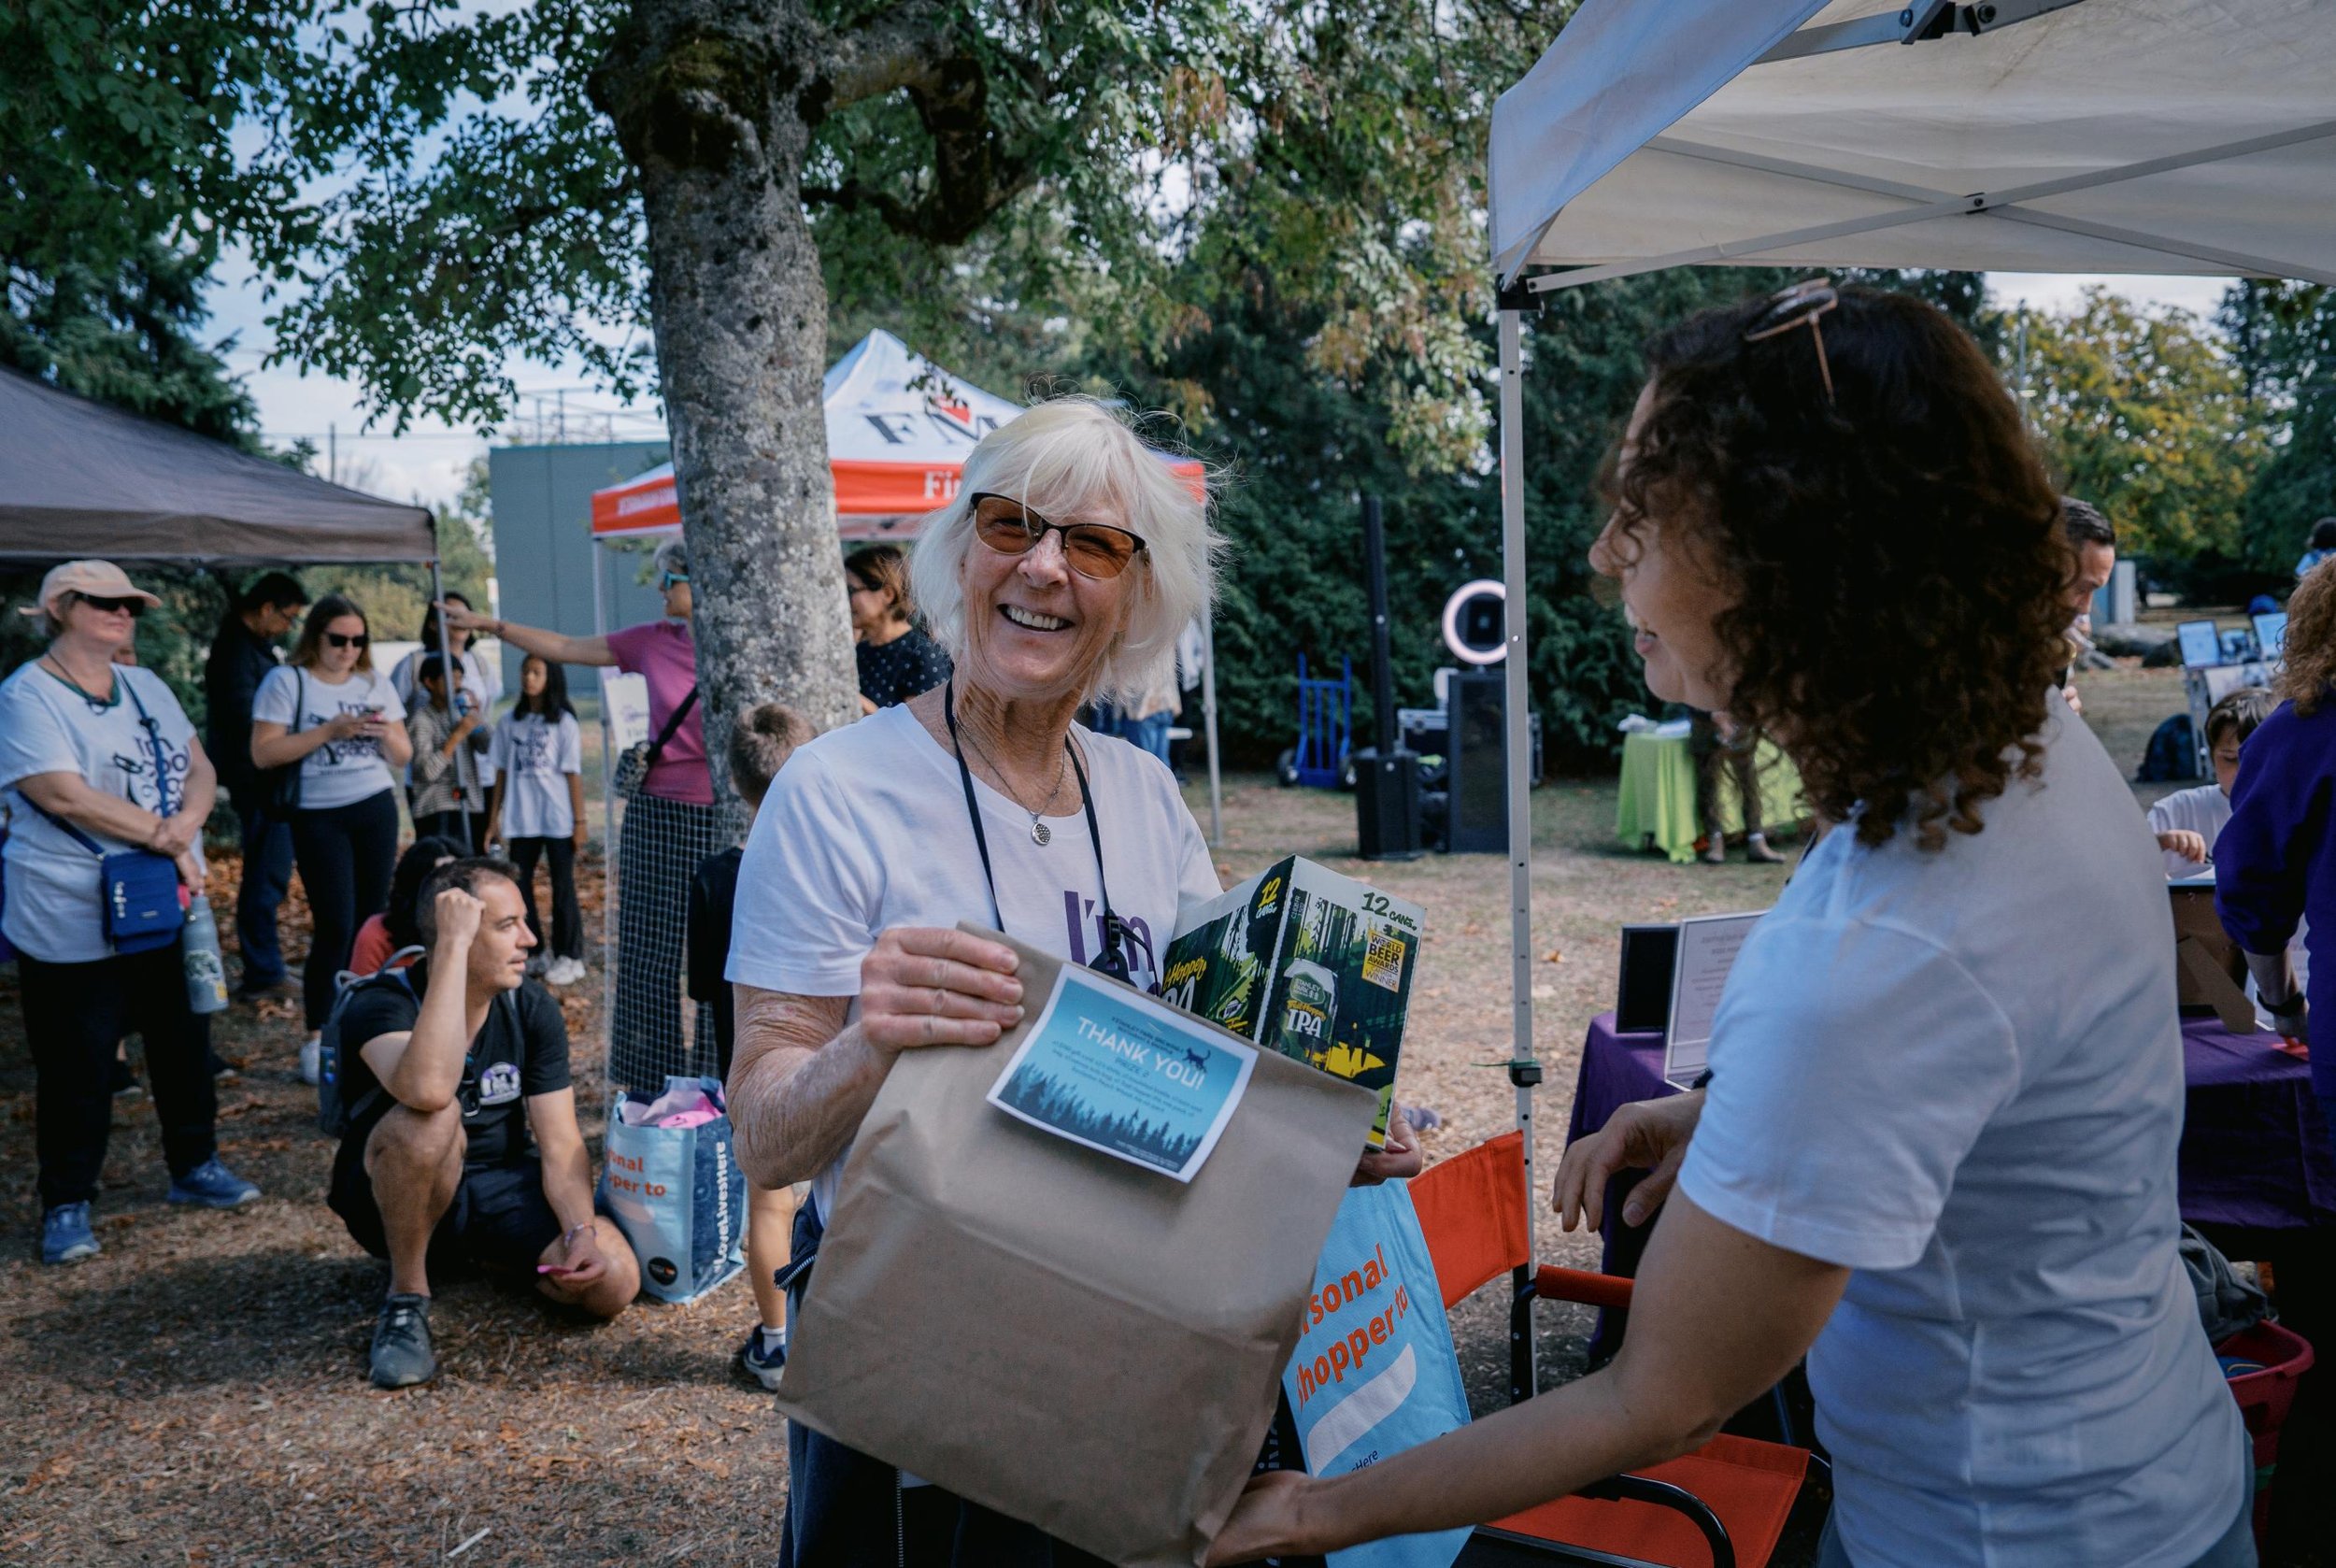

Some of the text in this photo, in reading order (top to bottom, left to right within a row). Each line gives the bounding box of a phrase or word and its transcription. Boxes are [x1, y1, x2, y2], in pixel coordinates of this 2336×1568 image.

[1258, 877, 1281, 908] 12
[1361, 891, 1390, 918] 12
[1368, 944, 1400, 966] BEER
[1371, 934, 1402, 954] WORLD
[1367, 956, 1399, 974] AWARDS
[1366, 970, 1397, 989] WINNER
[1287, 1009, 1321, 1038] IPA
[1077, 1016, 1150, 1064] THANK
[1154, 1053, 1206, 1090] YOU!
[644, 1182, 666, 1197] to
